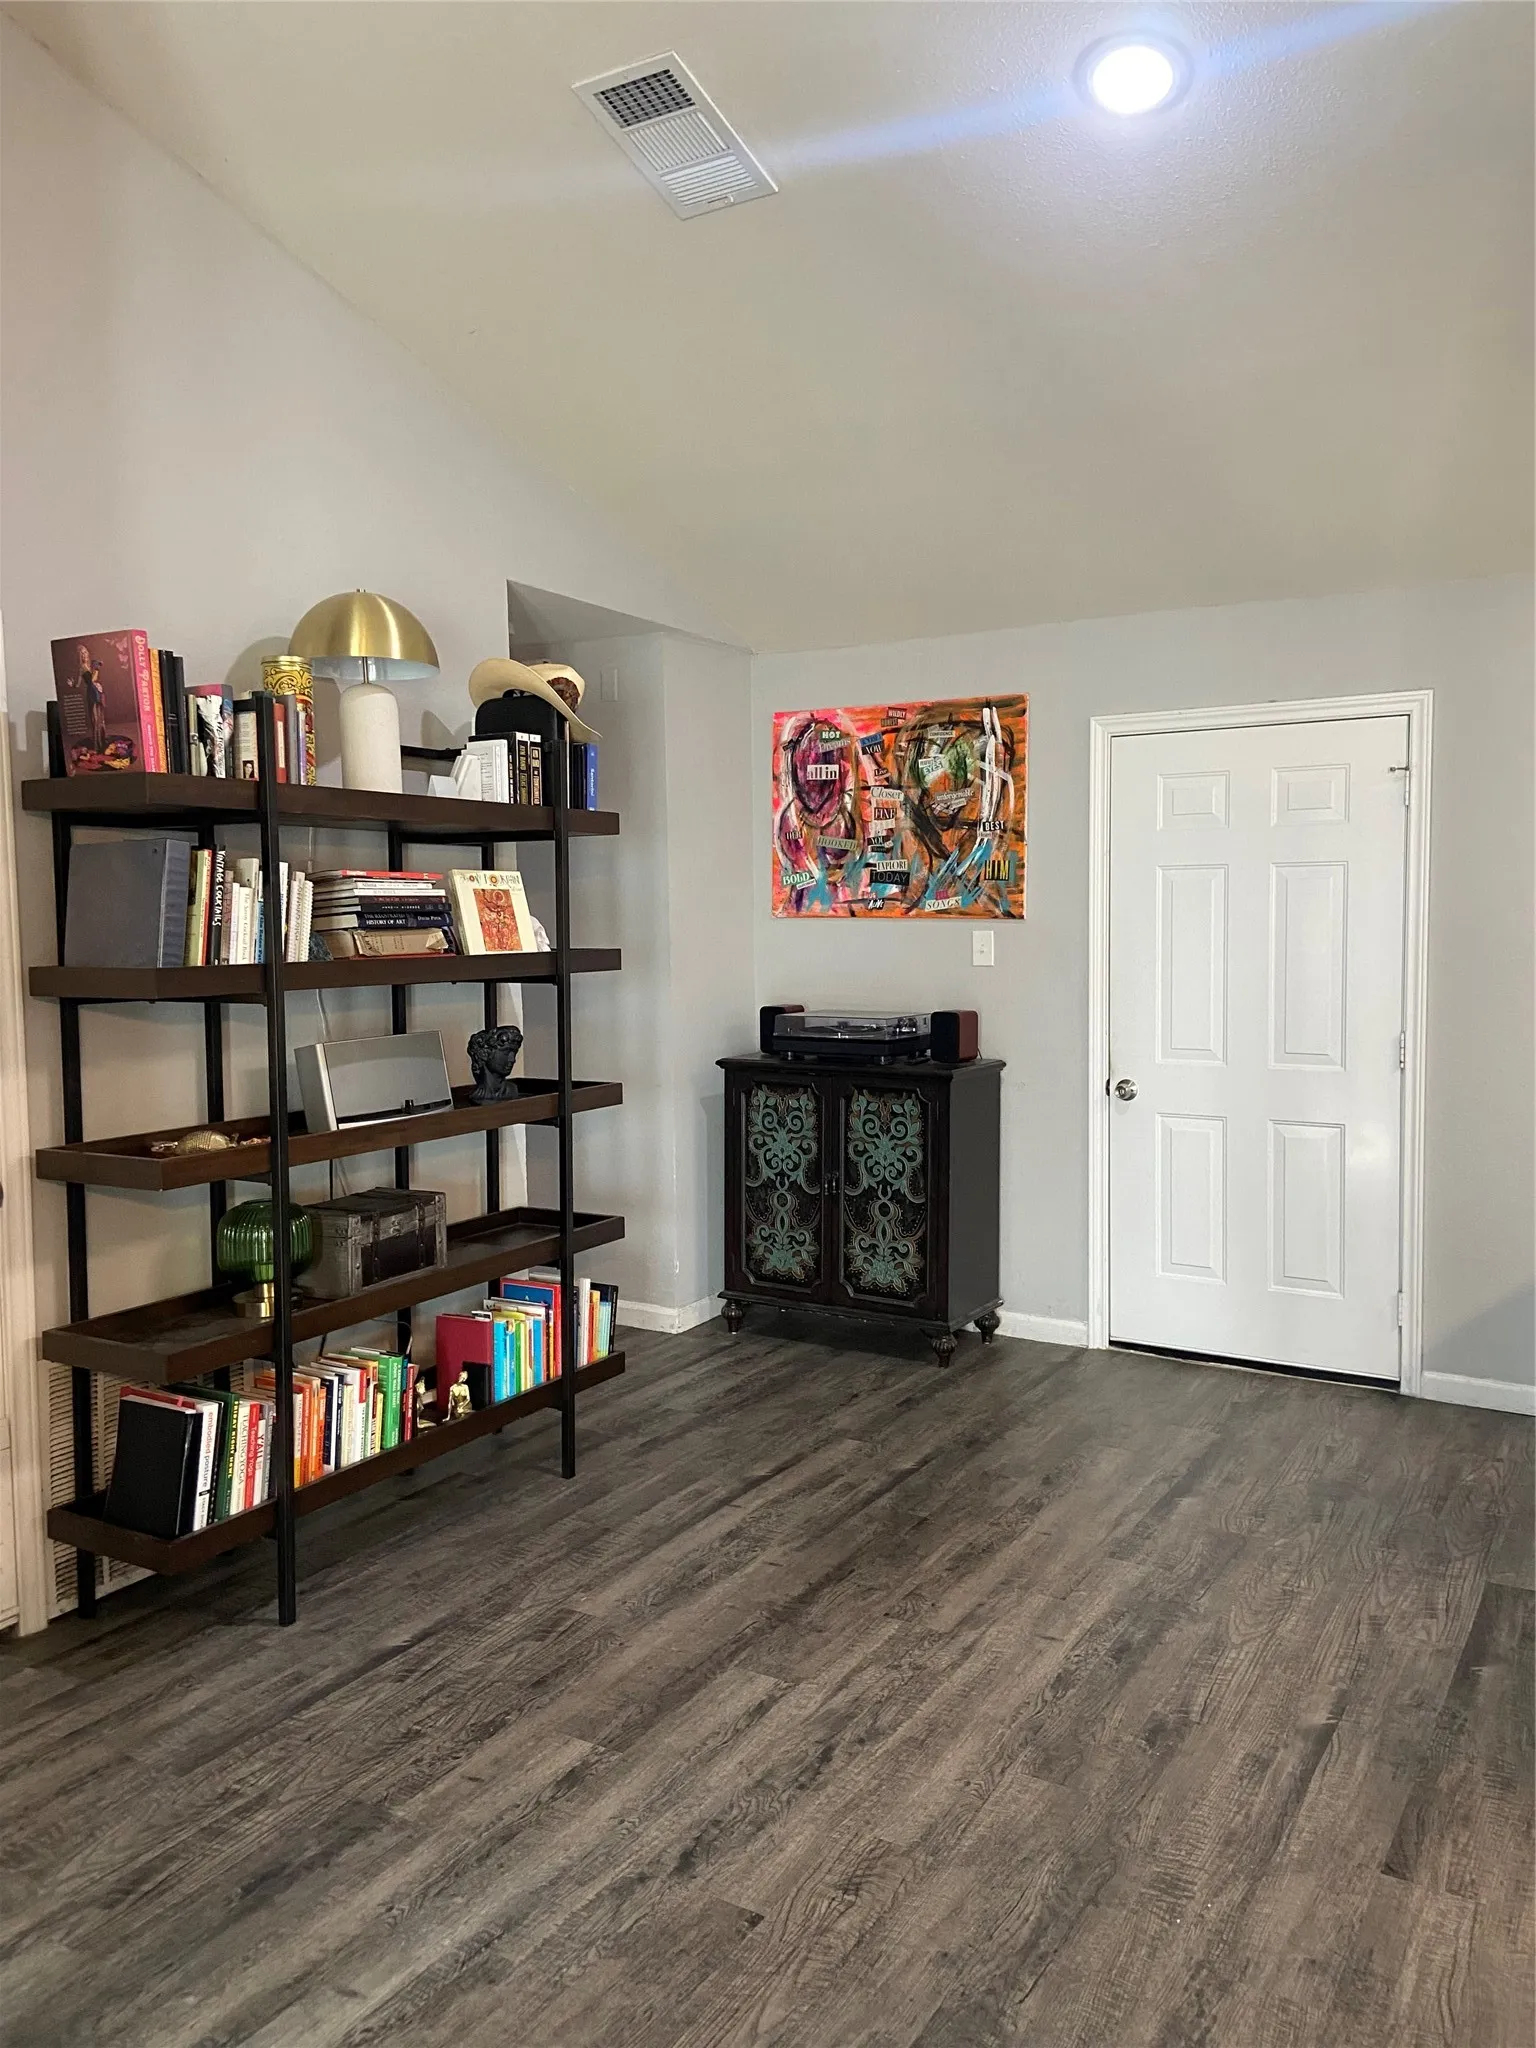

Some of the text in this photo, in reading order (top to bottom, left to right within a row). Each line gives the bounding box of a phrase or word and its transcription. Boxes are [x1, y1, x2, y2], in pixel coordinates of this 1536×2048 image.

[136, 636, 150, 712] DOLLY PARTON
[822, 731, 841, 739] HOT
[826, 766, 838, 779] in
[924, 762, 943, 776] EYES
[872, 788, 904, 800] Closer
[985, 820, 1004, 831] BEST
[878, 861, 907, 871] EXPLORE
[986, 860, 1009, 880] HIM
[783, 872, 810, 885] BOLD
[872, 871, 908, 883] TODAY
[213, 850, 225, 926] VINTAGE COCKTAILS
[926, 898, 961, 910] SONGS
[239, 1414, 249, 1458] TEACHING
[202, 1412, 214, 1487] embodied posture
[238, 1458, 247, 1485] YOGA
